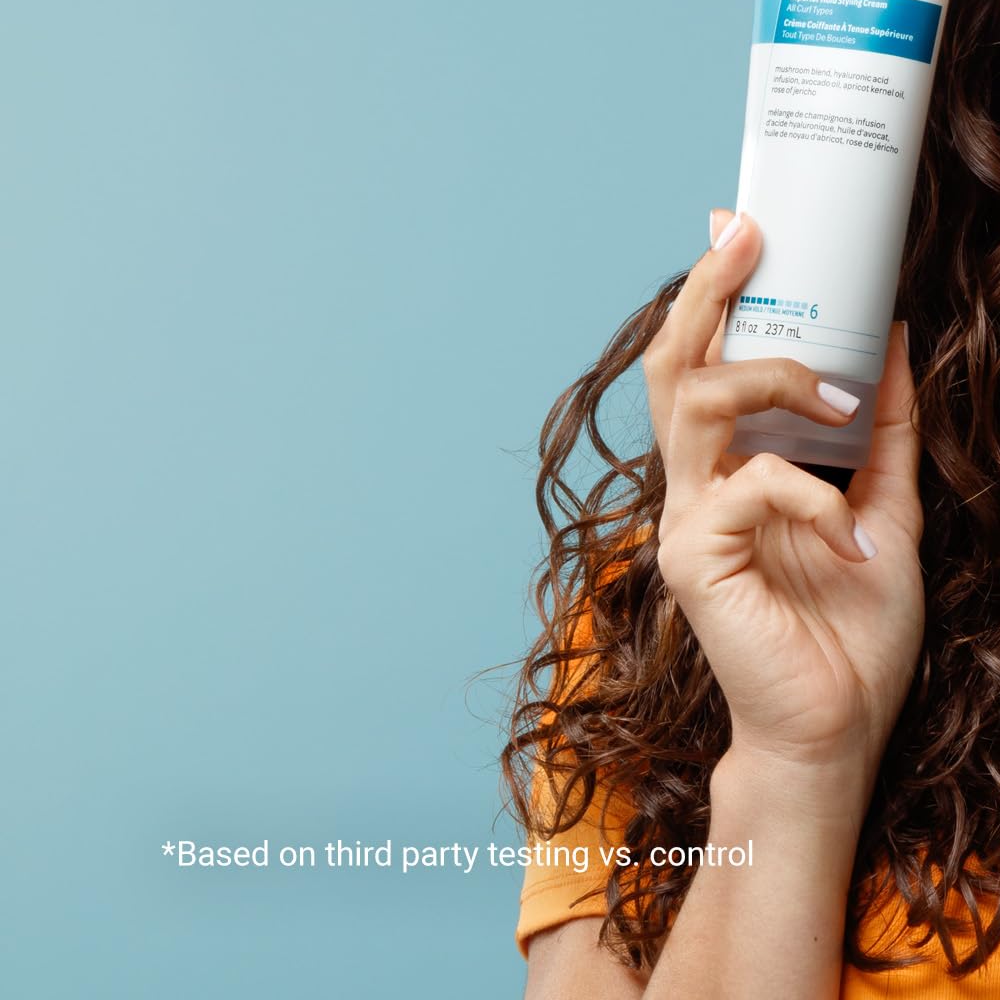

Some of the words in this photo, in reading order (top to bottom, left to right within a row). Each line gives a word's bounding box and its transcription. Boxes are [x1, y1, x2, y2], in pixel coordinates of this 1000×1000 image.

[786, 4, 796, 12] All
[797, 5, 811, 13] Curl
[813, 7, 833, 16] Types
[863, 0, 888, 9] Cream
[782, 30, 797, 38] Tout
[799, 31, 815, 41] Type
[816, 33, 826, 41] De
[827, 34, 856, 44] Boucles
[784, 19, 805, 28] Crème
[807, 20, 840, 32] Coiffante
[848, 24, 869, 34] Tenue
[870, 27, 914, 41] Supérieure
[775, 66, 809, 74] mushroom
[811, 68, 832, 77] blend,
[834, 70, 871, 82] hyaluronic
[873, 75, 889, 84] acid
[773, 75, 800, 84] infusion,
[801, 77, 830, 87] avocado
[843, 82, 870, 92] apricot
[870, 87, 894, 97] kernel
[895, 90, 905, 99] oil,
[786, 86, 793, 94] of
[792, 87, 816, 97] jericho
[768, 108, 794, 119] mélange
[804, 112, 854, 124] champignons,
[855, 118, 886, 129] infusion
[766, 119, 788, 127] d'acide
[789, 120, 836, 133] hyaluronique,
[837, 125, 856, 135] huile
[856, 130, 890, 142] d'avocat,
[764, 130, 779, 138] huile
[779, 130, 788, 138] de
[789, 132, 809, 141] noyau
[810, 133, 845, 145] d'abricot,
[846, 139, 863, 147] rose
[863, 140, 874, 149] de
[873, 142, 899, 154] jéricho
[810, 304, 818, 319] 6
[735, 320, 740, 332] 8
[742, 320, 746, 333] fl
[748, 324, 758, 333] oz
[765, 323, 784, 336] 237
[786, 326, 802, 338] mL
